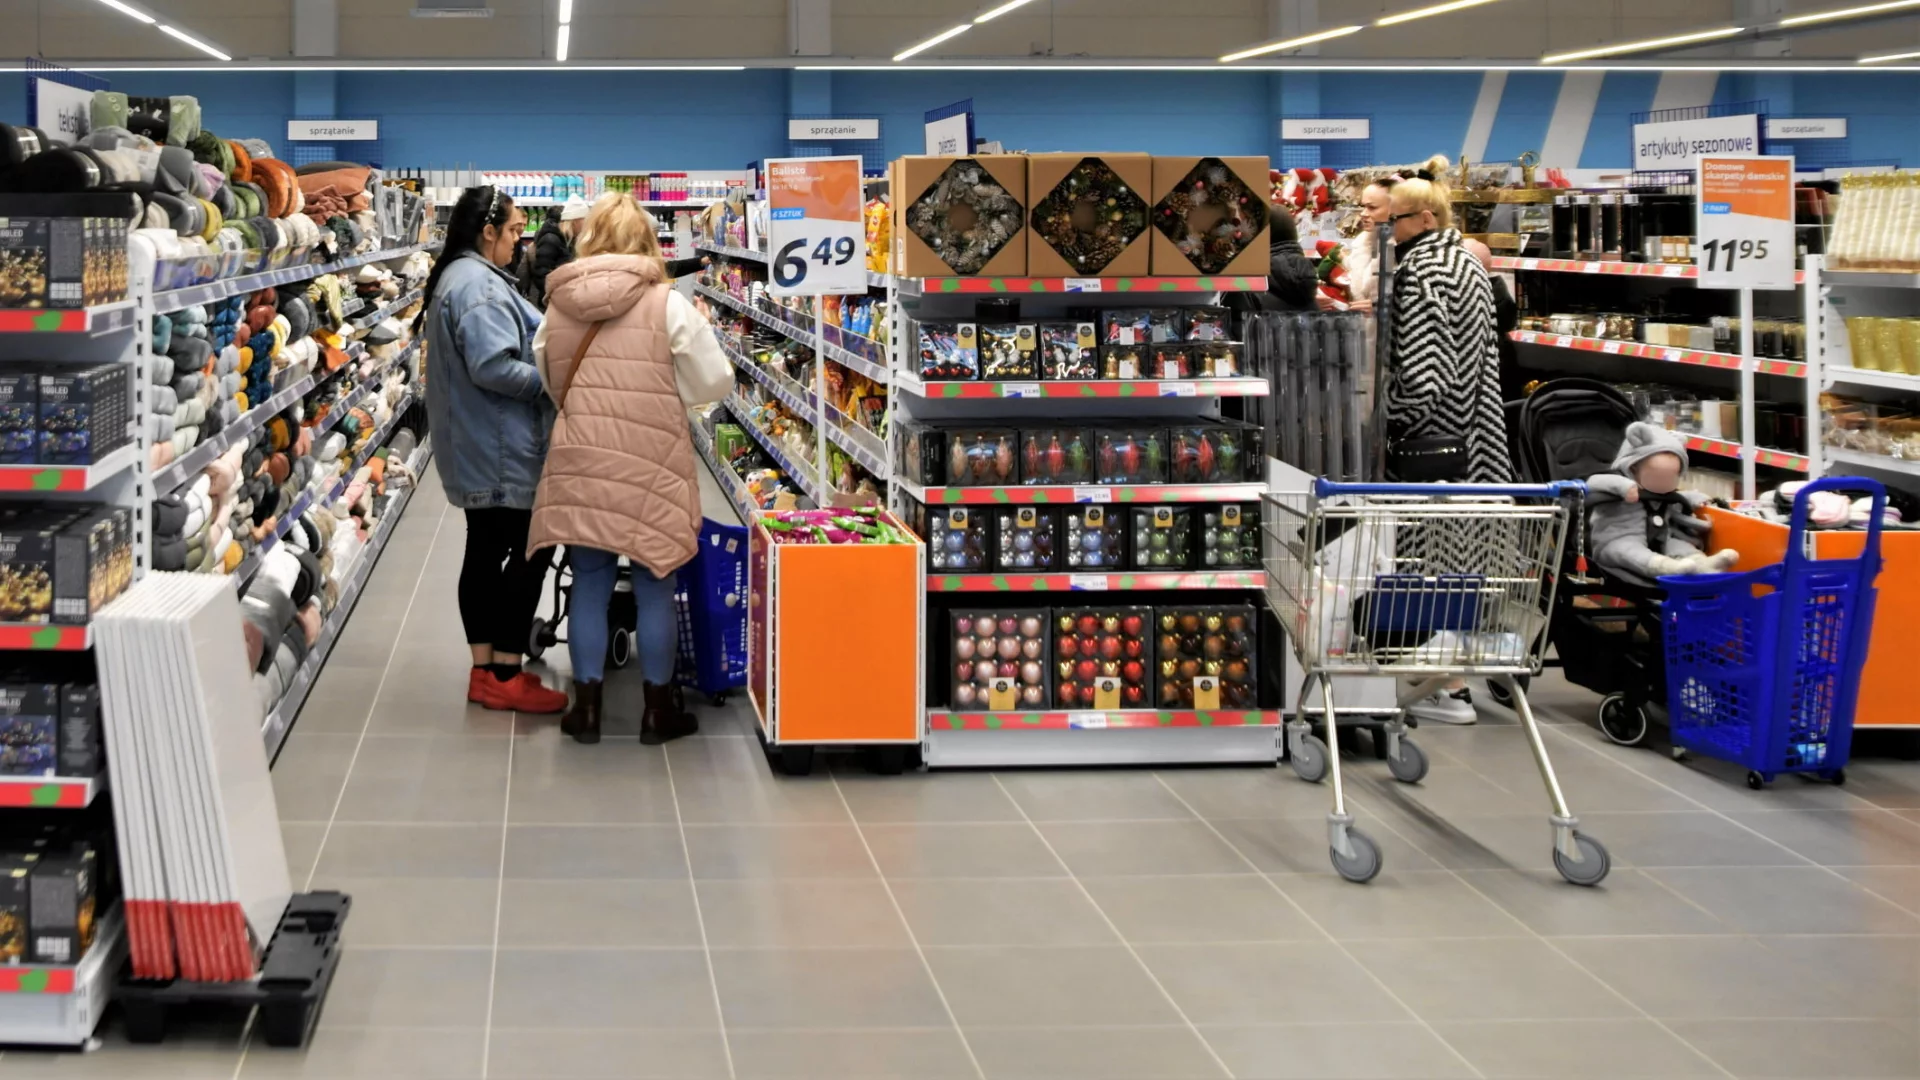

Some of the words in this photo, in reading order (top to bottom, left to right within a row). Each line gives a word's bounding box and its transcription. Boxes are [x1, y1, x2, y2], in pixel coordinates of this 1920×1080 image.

[309, 127, 355, 136] sprzątanie
[810, 126, 856, 136] sprzątanie
[1303, 125, 1348, 135] sprzątanie
[1640, 136, 1689, 160] artykuły
[1691, 137, 1753, 154] sezonowe
[772, 166, 806, 176] Balisto
[1704, 162, 1745, 171] Domowe
[1704, 171, 1746, 182] skarpety
[1747, 171, 1786, 181] damskie
[779, 210, 803, 218] SZTUK
[1703, 239, 1738, 272] 11
[1740, 240, 1769, 260] 95
[773, 238, 808, 288] 6
[811, 236, 856, 266] 49
